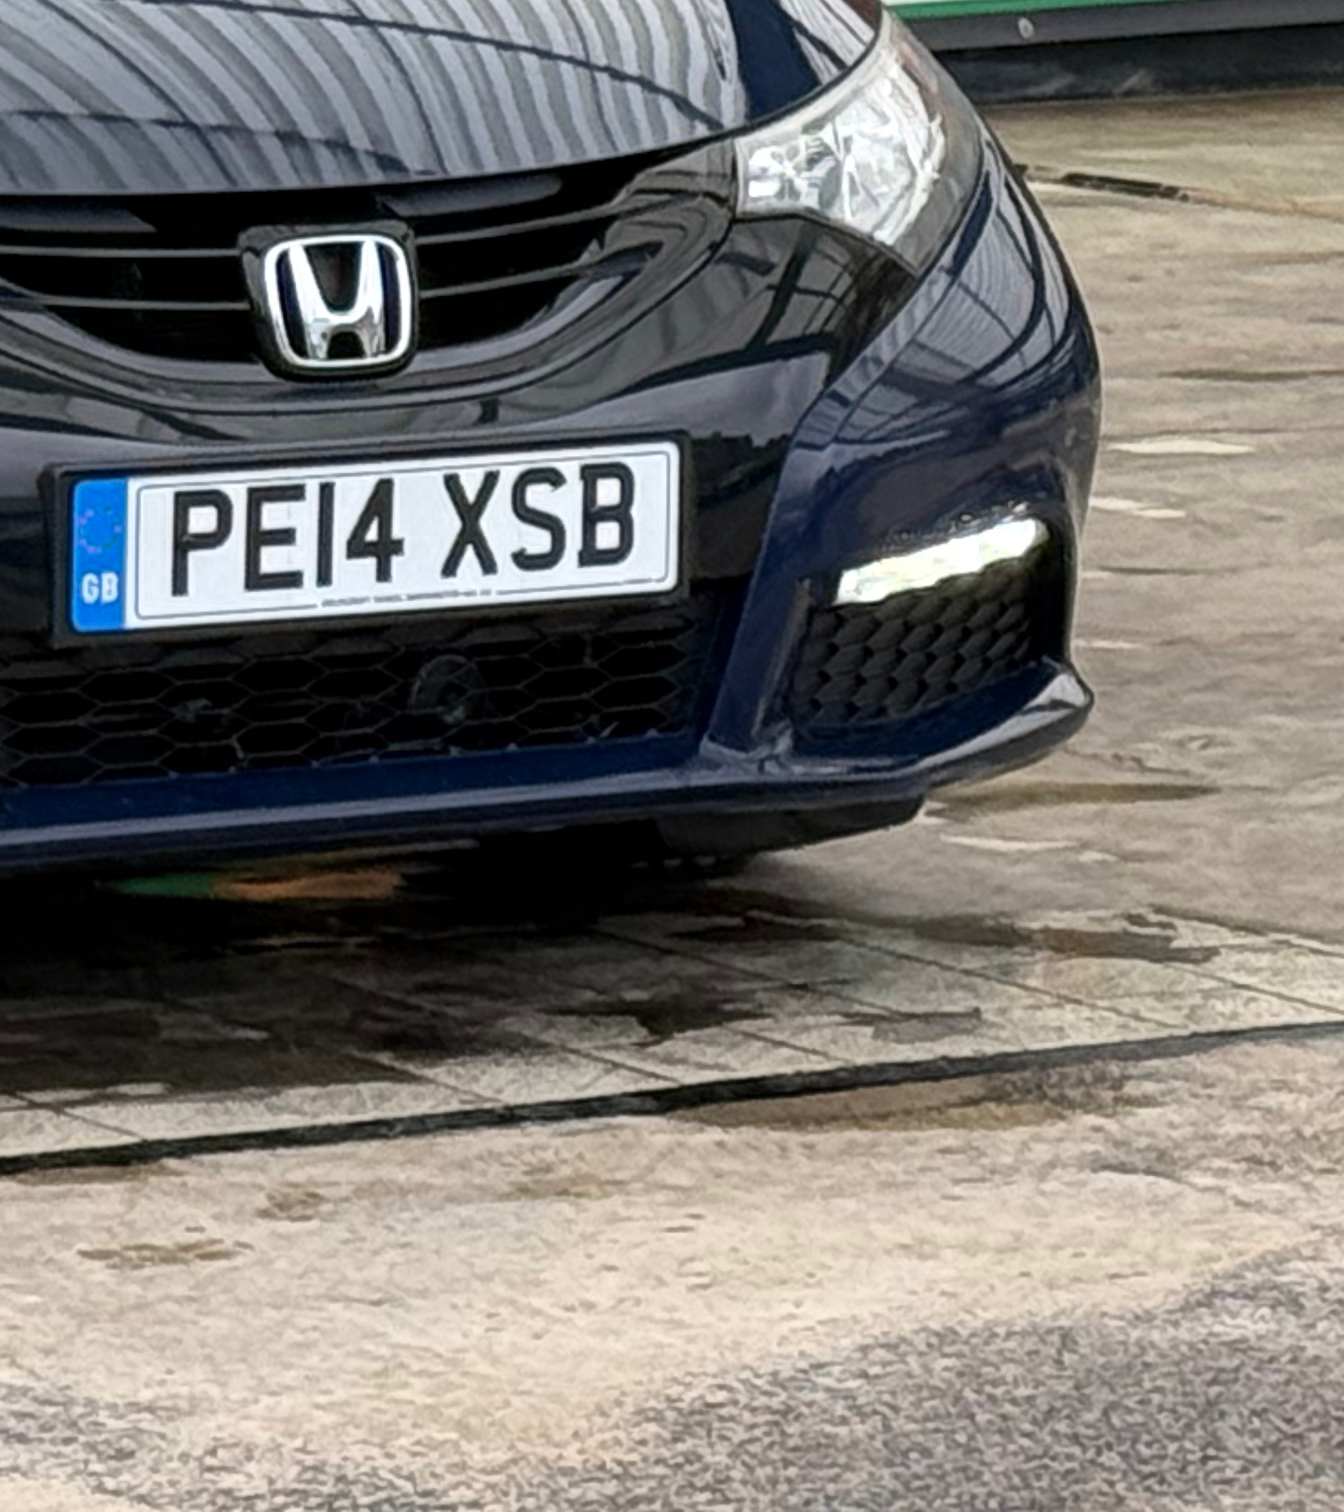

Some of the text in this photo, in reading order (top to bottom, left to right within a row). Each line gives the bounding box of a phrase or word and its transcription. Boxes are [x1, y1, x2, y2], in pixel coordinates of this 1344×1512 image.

[171, 461, 635, 596] PE14 XSB
[82, 572, 118, 604] GB
